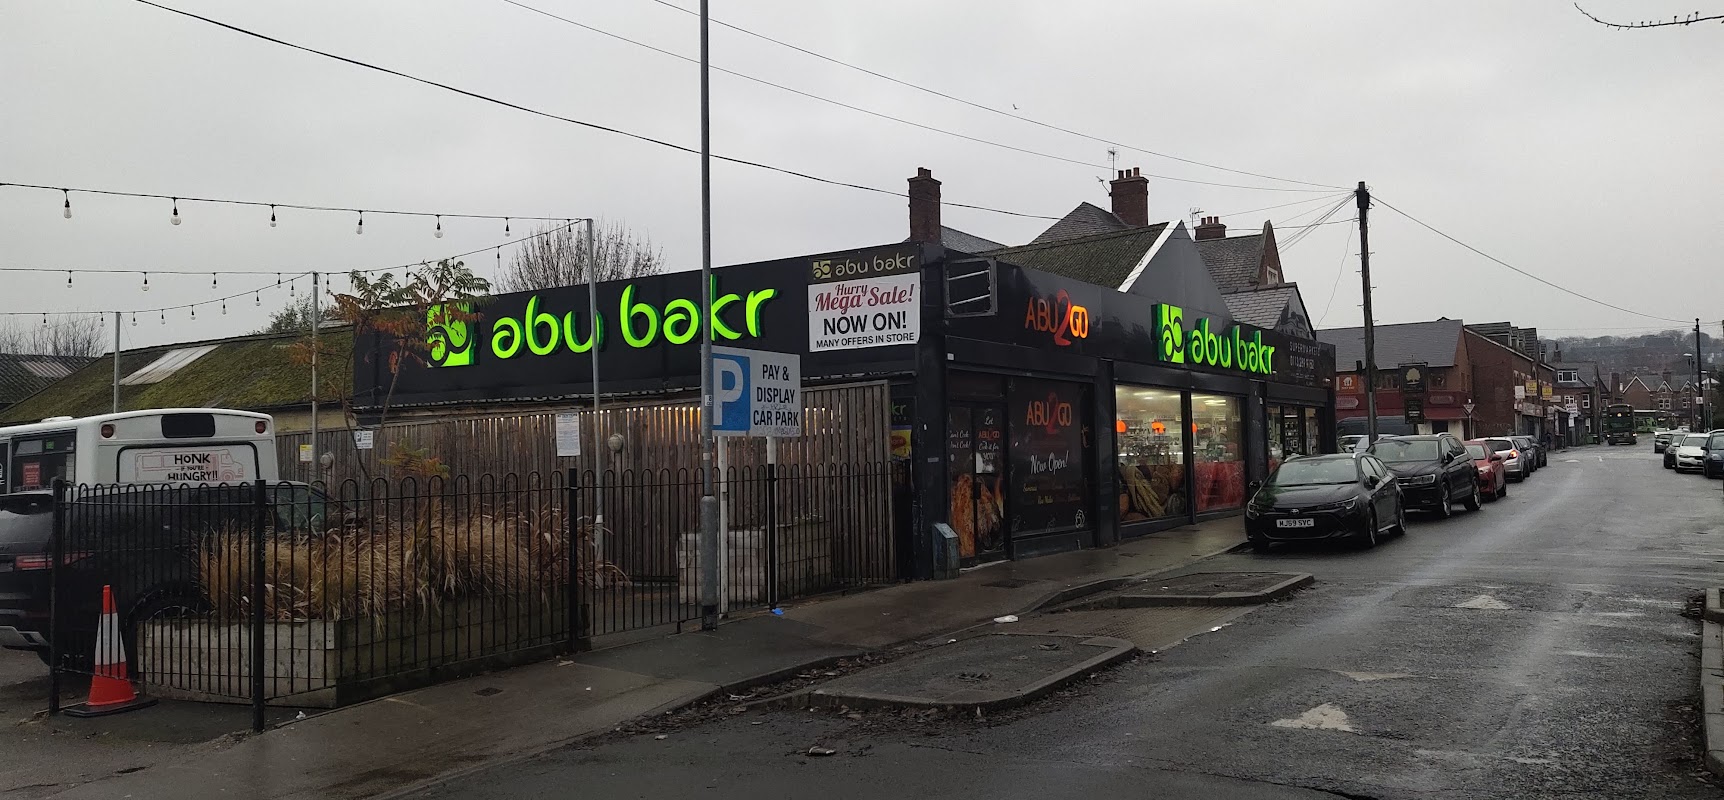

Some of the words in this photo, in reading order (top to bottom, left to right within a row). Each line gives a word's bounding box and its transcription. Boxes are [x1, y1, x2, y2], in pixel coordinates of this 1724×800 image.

[836, 259, 868, 276] abu
[873, 253, 914, 271] bakr
[815, 292, 863, 315] Mega
[867, 284, 914, 307] Sale!
[835, 284, 868, 296] Hurry
[491, 295, 605, 359] abu
[620, 273, 777, 349] bakr
[823, 315, 868, 336] NOW
[872, 311, 907, 331] ON!
[816, 339, 840, 348] MANY
[841, 336, 874, 346] OFFERS
[875, 334, 884, 343] IN
[886, 332, 915, 343] STORE
[1190, 318, 1232, 368] abu
[1235, 325, 1275, 375] bakr
[762, 364, 780, 380] PAY
[782, 366, 790, 381] &
[713, 358, 744, 426] P
[756, 387, 796, 404] DISPLAY
[753, 410, 773, 426] CAR
[775, 411, 799, 427] PARK
[1030, 454, 1047, 475] Now
[1048, 450, 1070, 475] Open!
[168, 470, 218, 481] HUNGRY!!
